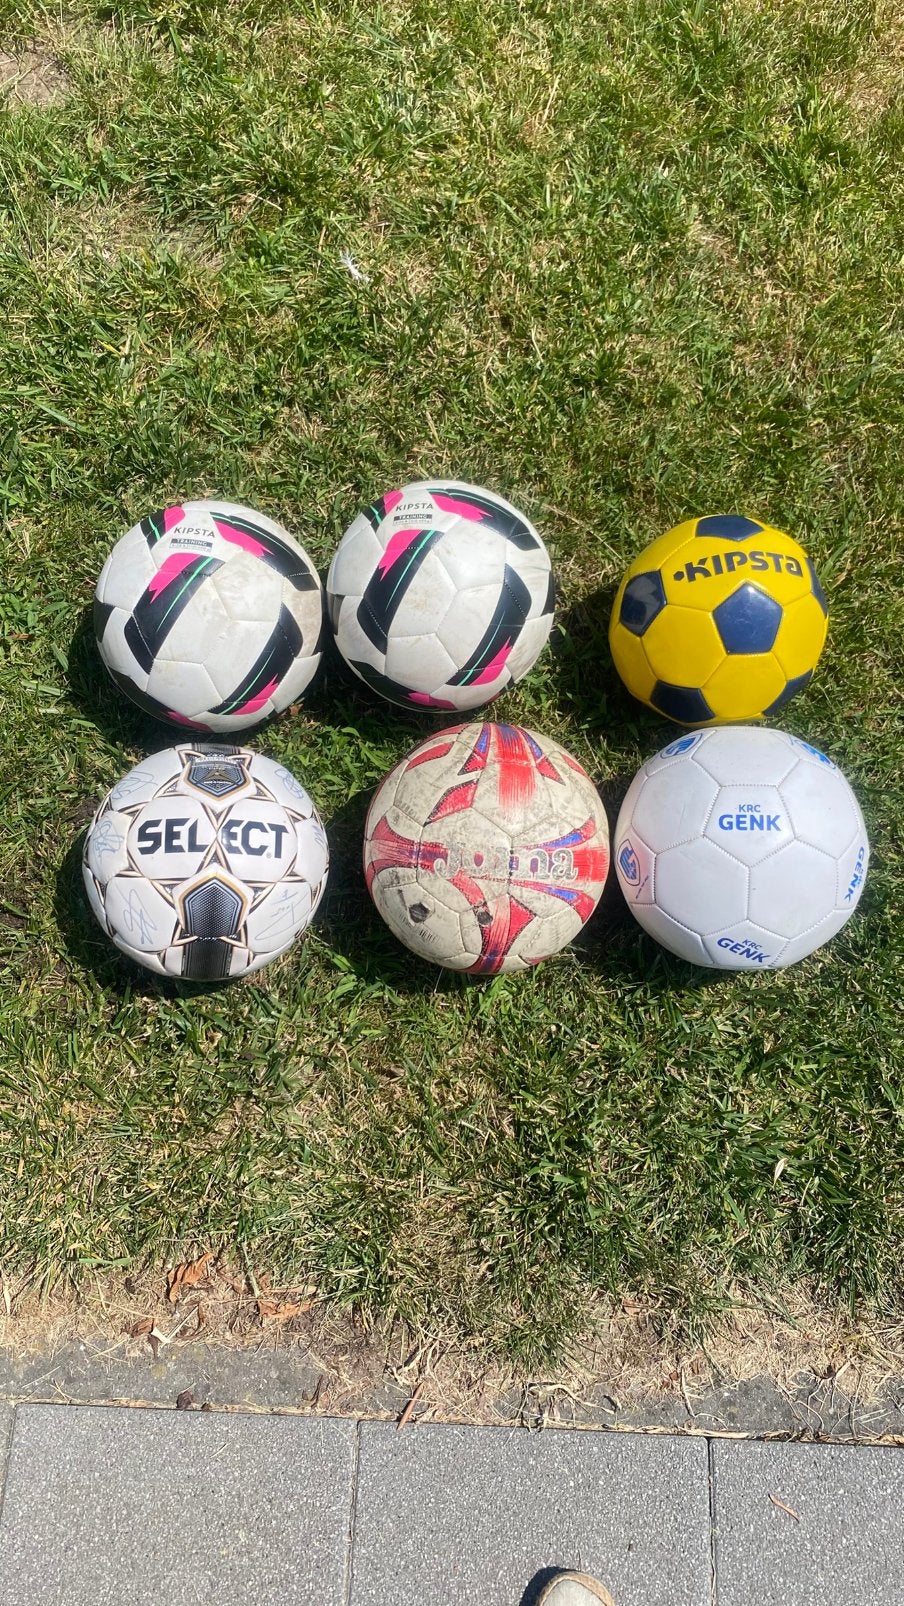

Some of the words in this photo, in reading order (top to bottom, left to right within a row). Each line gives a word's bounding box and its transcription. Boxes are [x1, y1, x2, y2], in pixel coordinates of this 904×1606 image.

[396, 502, 434, 512] KIPSTA
[400, 513, 428, 521] TRAINING
[173, 526, 216, 538] KIPSTA
[177, 538, 208, 547] TRAINING
[738, 804, 762, 813] KRC
[718, 814, 782, 831] GENK
[137, 817, 289, 859] SELECT
[843, 846, 865, 902] GENK
[717, 937, 771, 963] GENK
[741, 939, 763, 950] KRC
